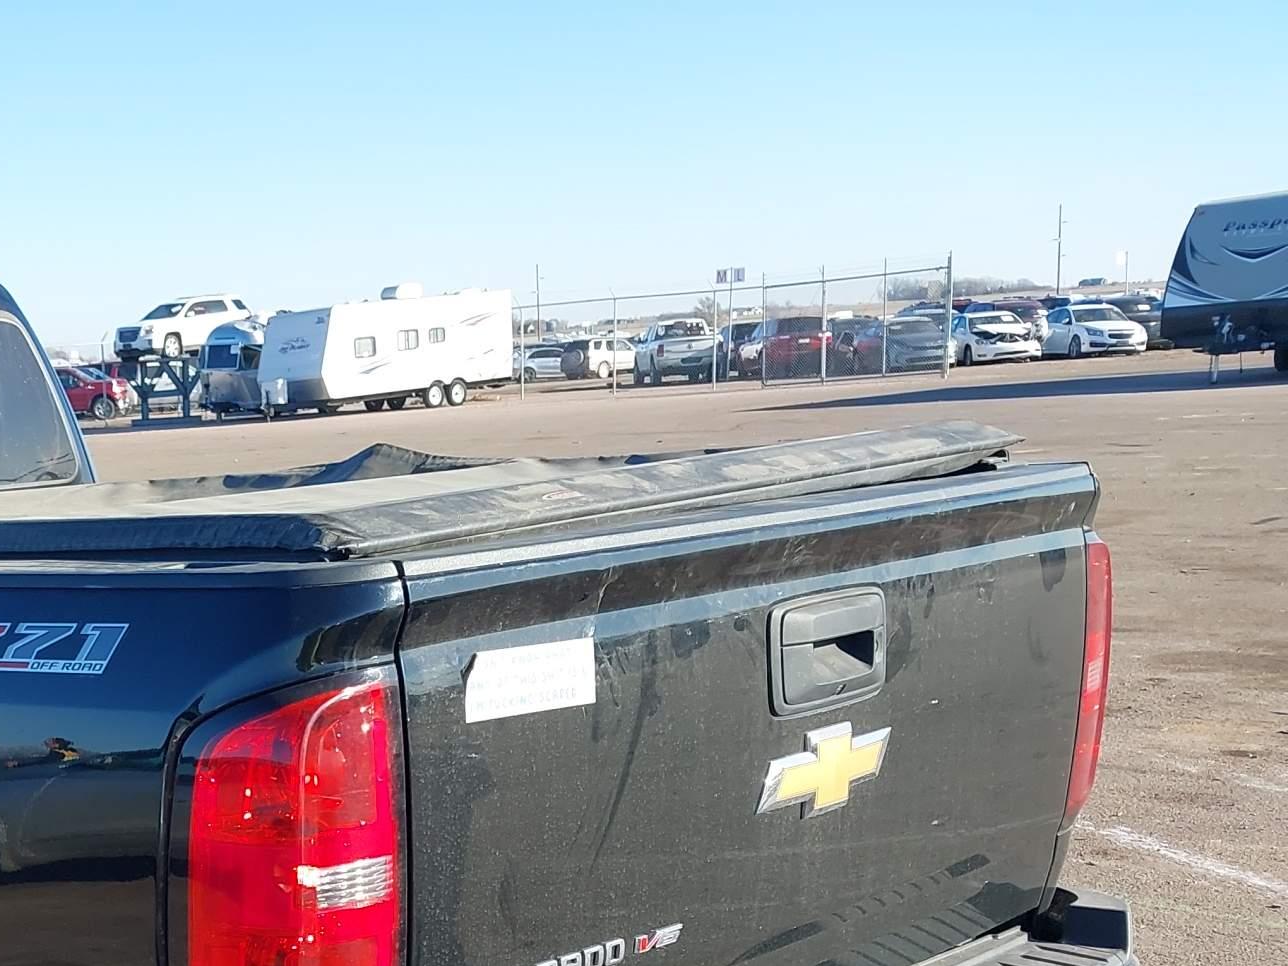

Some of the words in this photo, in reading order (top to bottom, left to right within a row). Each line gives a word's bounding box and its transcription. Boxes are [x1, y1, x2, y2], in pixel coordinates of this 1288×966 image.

[716, 270, 727, 283] M
[30, 661, 59, 670] OFF
[62, 662, 104, 672] ROAD
[633, 923, 684, 954] V6
